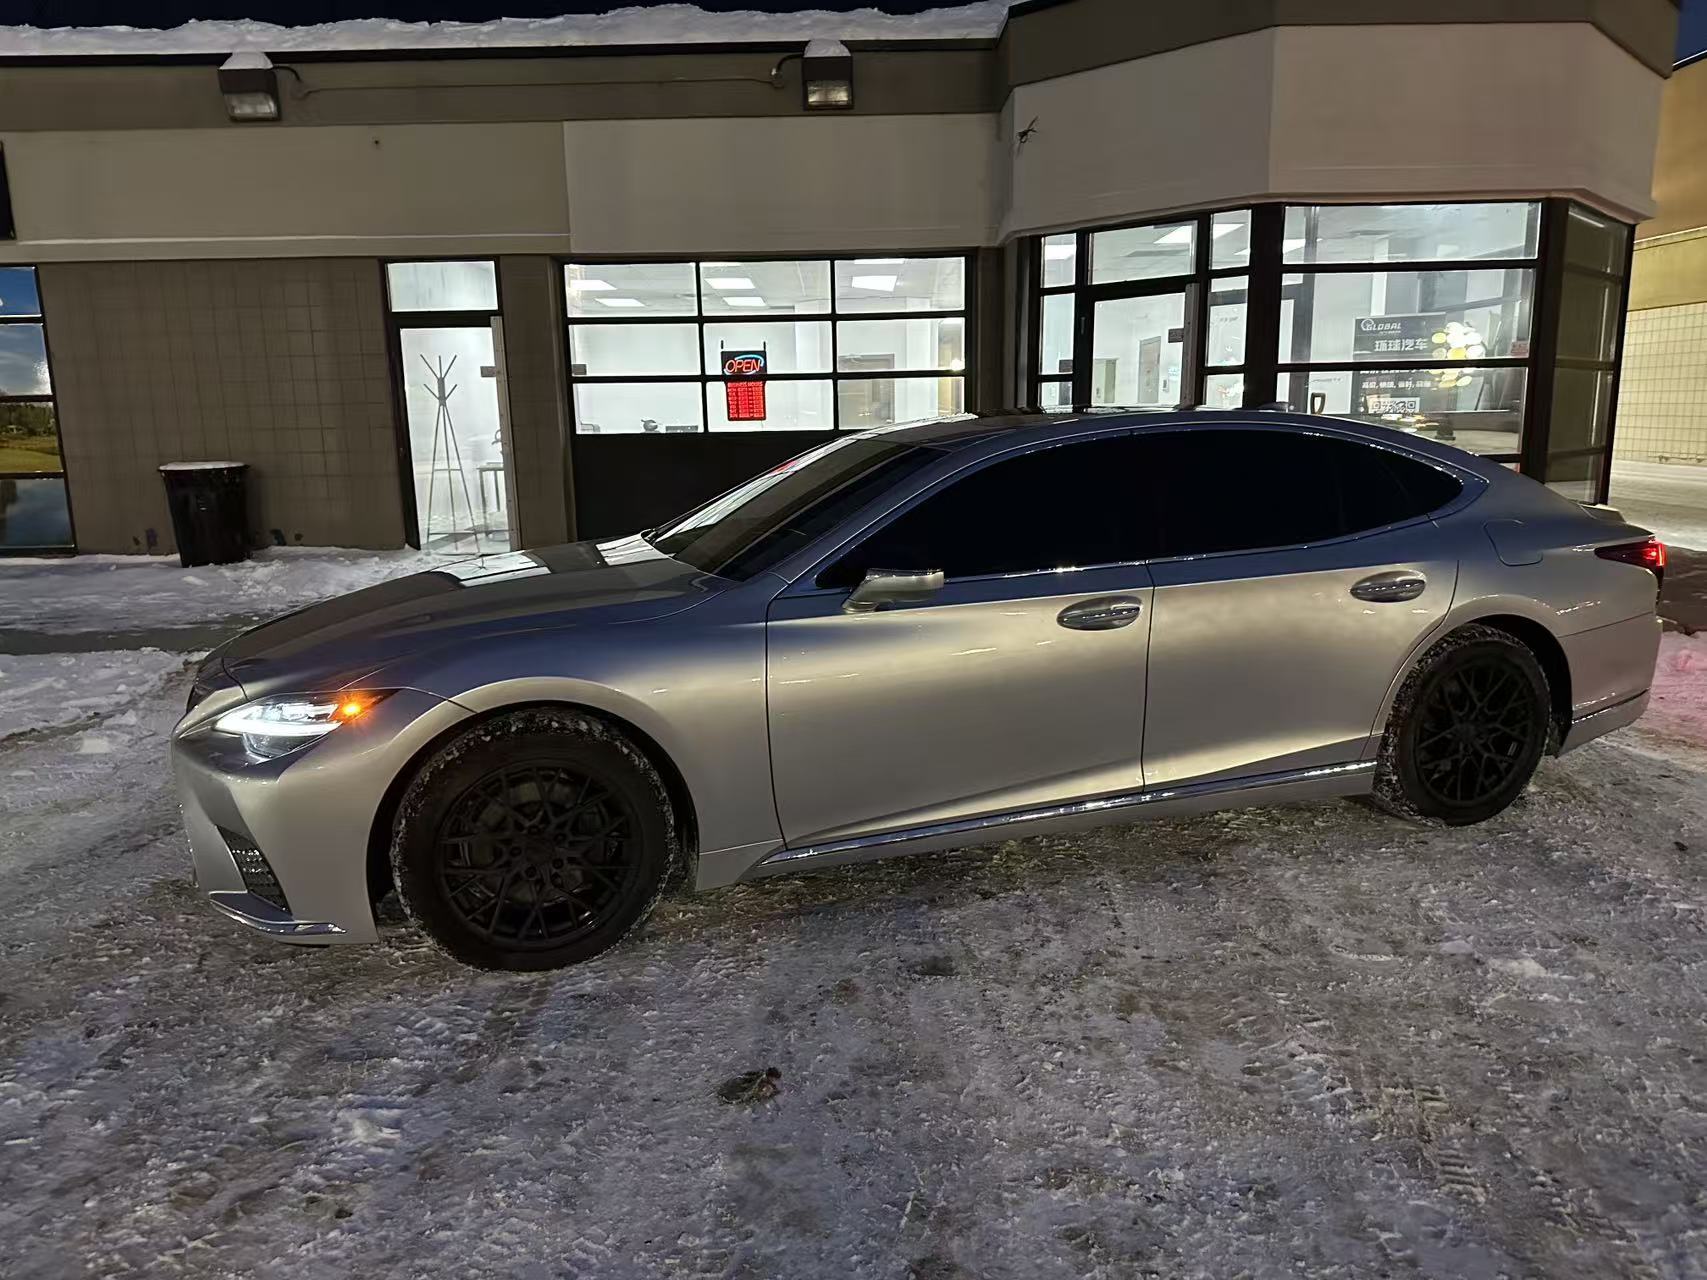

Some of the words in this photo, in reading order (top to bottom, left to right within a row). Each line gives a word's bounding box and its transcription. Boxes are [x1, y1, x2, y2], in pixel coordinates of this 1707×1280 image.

[1365, 322, 1402, 331] GLOBAL
[1374, 338, 1429, 352] 环球汽车
[726, 359, 761, 373] OPEN
